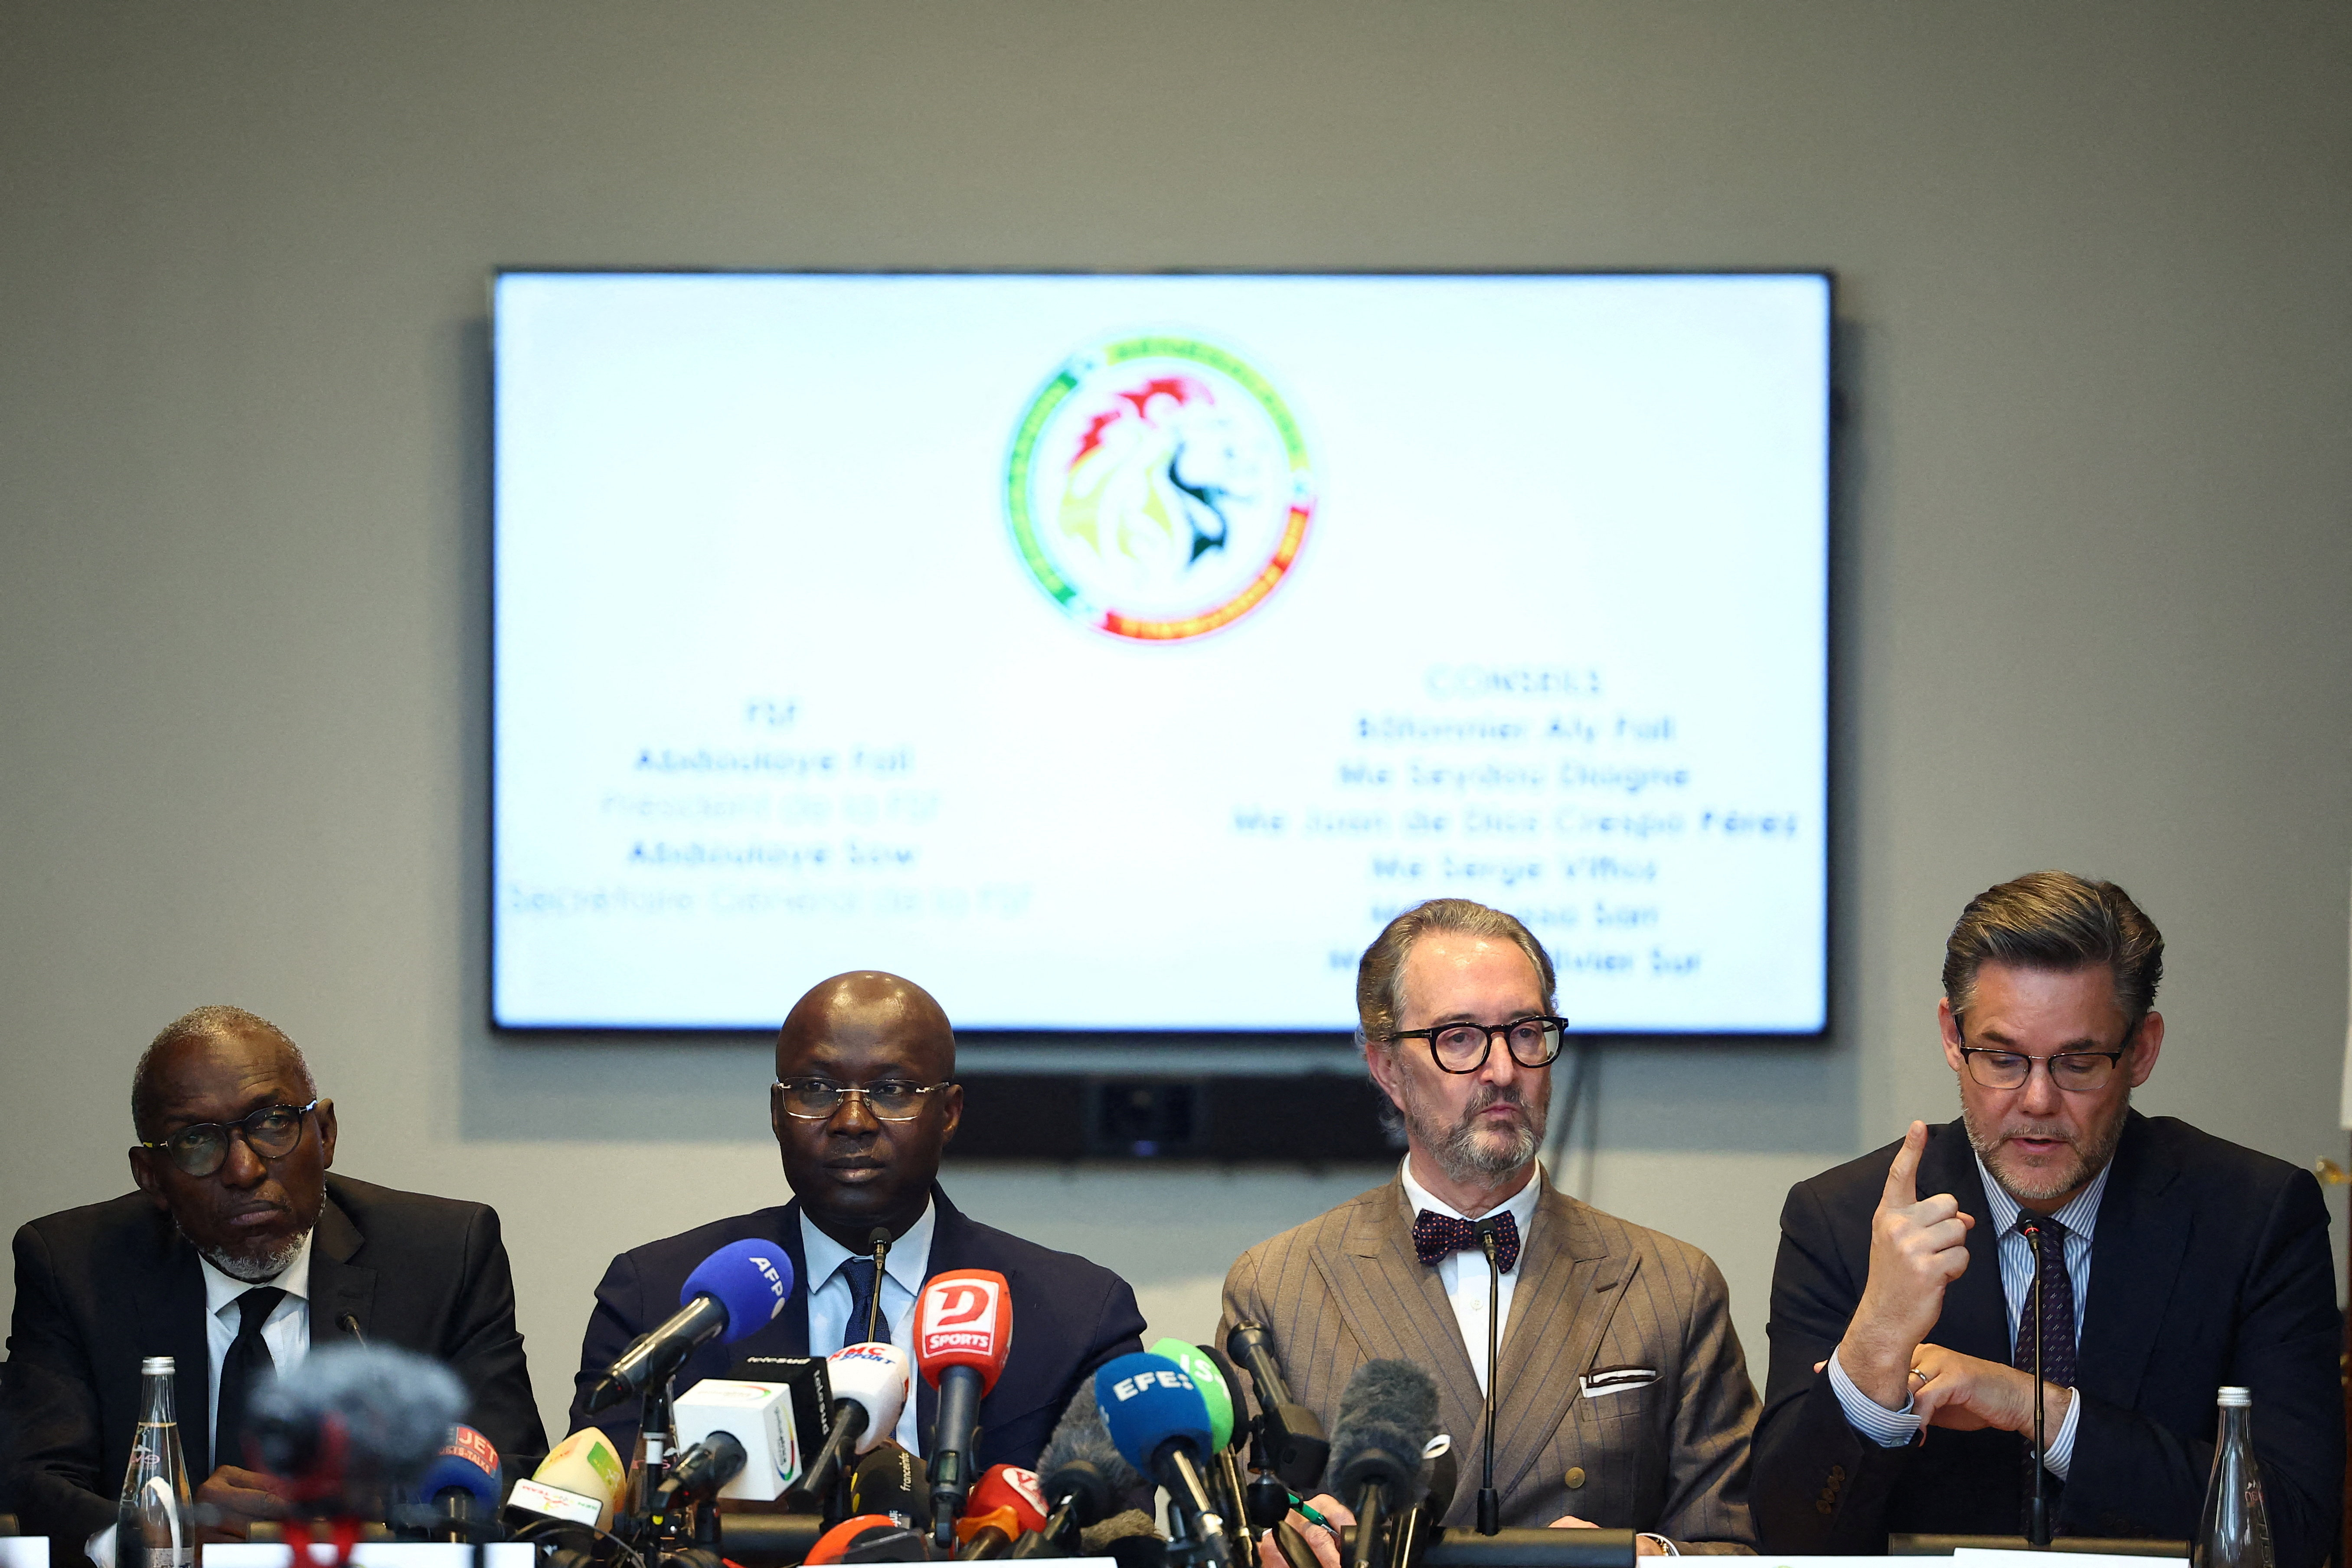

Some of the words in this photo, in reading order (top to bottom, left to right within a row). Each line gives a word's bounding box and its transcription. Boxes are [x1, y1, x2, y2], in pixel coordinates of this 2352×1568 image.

[748, 1257, 784, 1297] AFP
[929, 1333, 989, 1349] SPORTS
[458, 1431, 498, 1463] JET
